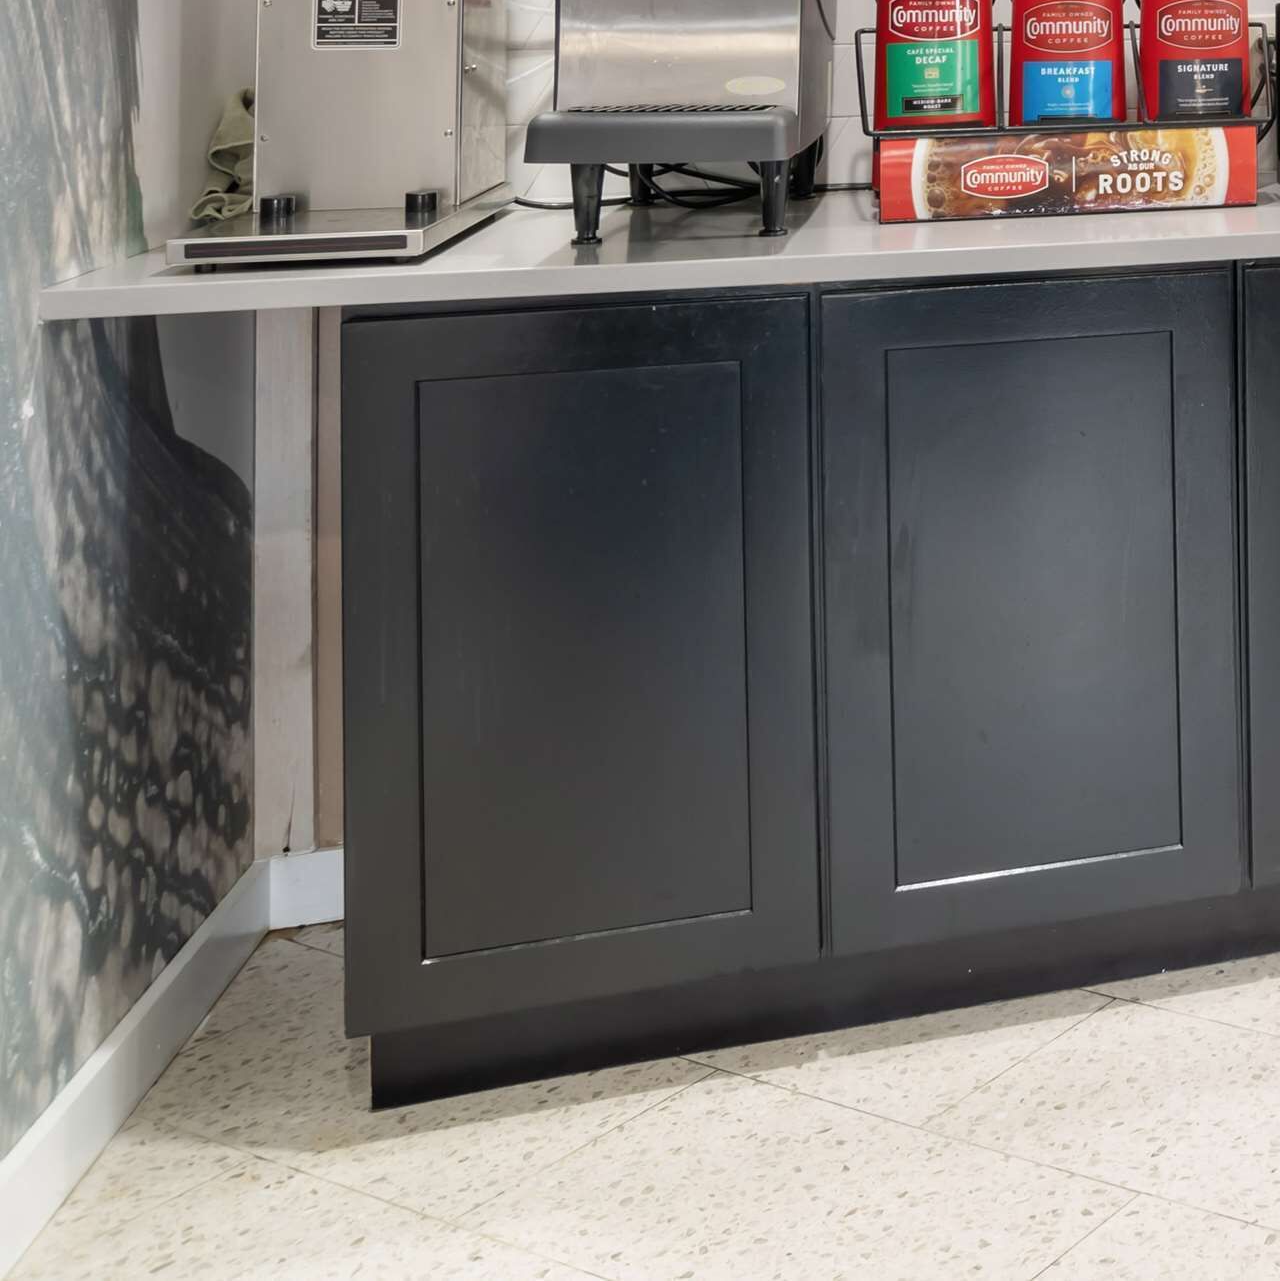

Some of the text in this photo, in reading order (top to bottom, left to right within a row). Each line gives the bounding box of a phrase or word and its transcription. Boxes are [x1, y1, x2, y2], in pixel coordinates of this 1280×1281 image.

[893, 5, 976, 28] Community
[1161, 13, 1240, 36] Community
[1026, 15, 1110, 40] Community
[915, 55, 948, 64] DECAF
[1177, 63, 1229, 73] SIGNATURE
[1040, 67, 1096, 76] BREAKFAST
[1110, 149, 1172, 167] STRONG
[1139, 162, 1155, 170] OUR
[966, 167, 1044, 188] Community
[1098, 170, 1184, 195] ROOTS
